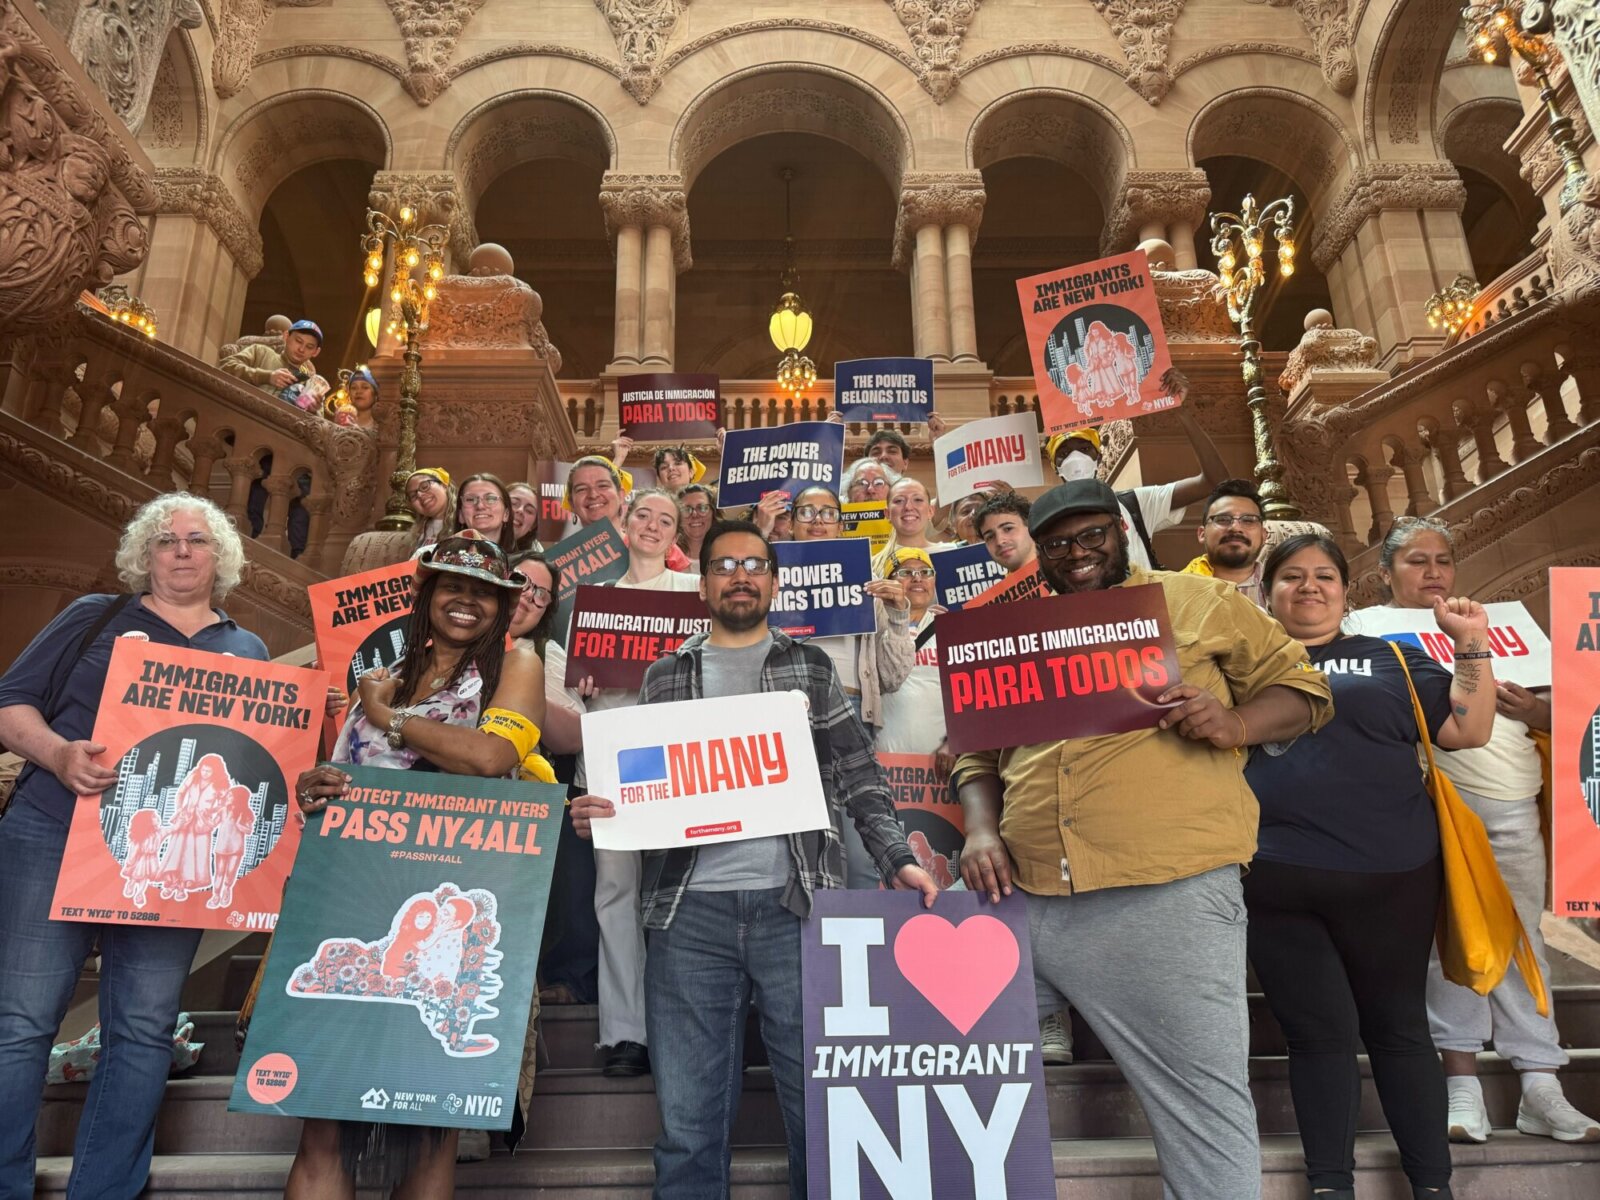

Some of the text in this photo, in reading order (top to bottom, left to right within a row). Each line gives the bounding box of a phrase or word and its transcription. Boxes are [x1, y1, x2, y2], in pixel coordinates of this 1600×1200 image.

[1035, 263, 1130, 298] IMMIGRANTS
[1033, 275, 1145, 314] ARE NEW YORK!
[852, 373, 917, 389] THE POWER
[622, 388, 716, 402] JUSTICIA DE INMIGRACIÓN
[841, 389, 928, 404] BELONGS TO US
[622, 401, 717, 425] PARA TODOS
[743, 442, 820, 464] THE POWER
[965, 434, 1026, 470] MANY
[727, 461, 833, 485] BELONGS TO US
[948, 463, 967, 479] FOR THE
[859, 511, 880, 519] YORK
[554, 531, 610, 568] GRANT NYERS
[778, 563, 843, 588] POWER
[956, 563, 985, 584] THE
[335, 575, 413, 608] IMMIGR
[811, 587, 834, 609] TO
[836, 585, 863, 607] US
[332, 604, 370, 628] ARE
[577, 612, 713, 635] IMMIGRATION JUST
[574, 631, 616, 659] FOR
[620, 635, 660, 661] THE
[947, 617, 1160, 666] JUSTICIA DE INMIGRACIÓN
[1420, 625, 1530, 663] MNY
[140, 660, 299, 704] IMMIGRANTS
[949, 645, 1169, 714] PARA TODOS
[121, 682, 311, 730] ARE NEW YORK!
[494, 715, 525, 730] NEW YORK
[667, 731, 789, 798] MANY
[339, 786, 550, 820] OTECT IMMIGRANT NYERS
[620, 782, 670, 804] FOR THE
[890, 785, 926, 803] NEW
[320, 805, 542, 856] PASS NY4ALL
[690, 825, 737, 835] forthemany.org
[389, 850, 463, 864] #PASSNY4ALL
[61, 907, 85, 917] TEXT
[116, 909, 129, 920] TO
[130, 911, 160, 922] 52886
[1566, 901, 1590, 912] TEXT
[246, 911, 280, 930] NYIC
[821, 917, 890, 1037] I
[812, 1042, 1034, 1079] IMMIGRANT
[255, 1069, 271, 1078] TEXT
[256, 1078, 265, 1086] TO
[392, 1101, 422, 1112] FOR ALL
[394, 1091, 438, 1104] NEW YORK
[464, 1094, 503, 1118] NYIC
[827, 1082, 1033, 1200] NY
